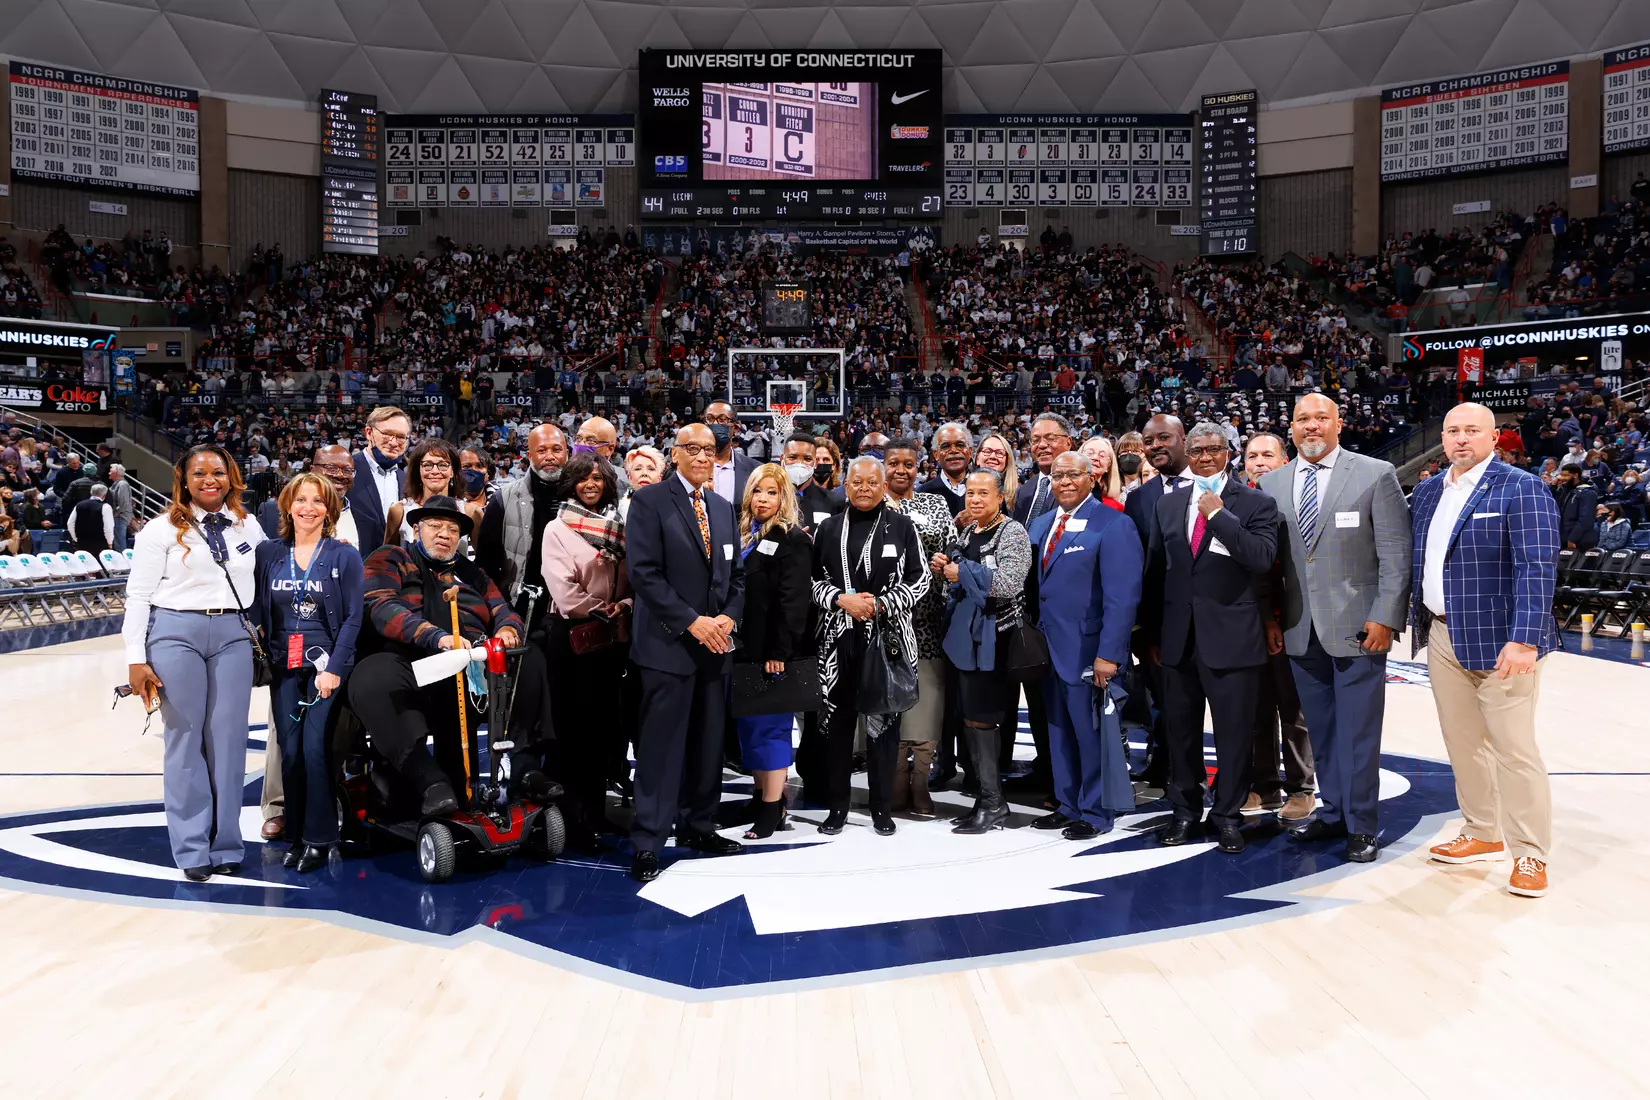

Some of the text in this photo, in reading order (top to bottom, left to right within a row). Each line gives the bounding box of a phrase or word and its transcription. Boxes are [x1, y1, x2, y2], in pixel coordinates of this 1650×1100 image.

[666, 54, 915, 68] UNIVERSITY OF CONNECTICUT
[22, 65, 188, 98] NCAA CHAMPIONSHIP
[1392, 64, 1557, 99] NCAA CHAMPIONSHIP
[1609, 73, 1628, 88] 1991
[20, 77, 190, 108] TOURNAMENT APPEARANCES
[652, 87, 690, 97] WELLS
[1204, 93, 1254, 105] GO HUSKIES
[1426, 90, 1464, 102] SWEET
[15, 86, 195, 123] 1989 1990 1991 1992 1993 1994 1995
[653, 98, 690, 107] FARGO
[1386, 85, 1564, 122] 1991 1994 1995 1996 1997 1998 1999
[1488, 120, 1564, 140] 2011 2012 2013
[745, 126, 753, 153] 3
[784, 131, 804, 162] C
[390, 145, 411, 159] 24
[421, 145, 442, 159] 50
[455, 145, 471, 159] 21
[485, 145, 504, 159] 52
[516, 145, 537, 159] 42
[549, 145, 565, 159] 25
[583, 145, 595, 159] 33
[615, 145, 626, 159] 10
[953, 144, 965, 159] 32
[987, 144, 993, 159] 3
[1047, 144, 1059, 159] 20
[1078, 144, 1089, 159] 31
[1108, 144, 1121, 159] 23
[1139, 144, 1152, 159] 31
[1171, 144, 1184, 159] 14
[1384, 137, 1562, 171] 2014 2015 2016 2017 2018 2019 2021
[1382, 153, 1566, 182] CONNECTICUT WOMEN'S BASKETBALL
[16, 170, 195, 197] CONNECTICUT WOMEN'S BASKETBALL
[782, 191, 808, 203] 4:49
[950, 184, 968, 199] 23
[985, 184, 994, 199] 4
[1013, 184, 1030, 199] 30
[1048, 184, 1057, 199] 3
[1074, 184, 1092, 199] CD
[1107, 184, 1121, 199] 15
[1135, 184, 1156, 199] 24
[1167, 184, 1187, 199] 33
[112, 205, 123, 213] 14
[644, 197, 663, 211] 44
[922, 196, 941, 211] 27
[392, 227, 408, 235] 201
[797, 230, 814, 238] Harry
[823, 230, 845, 238] Gampel
[1209, 228, 1248, 238] TIME OF DAY
[838, 238, 859, 246] Capital
[1224, 238, 1247, 251] 1:10
[776, 290, 804, 302] 4:49
[1425, 338, 1476, 351] FOLLOW
[1479, 324, 1629, 349] @UCONNHUSKIES
[1603, 346, 1620, 355] Lite
[47, 384, 99, 403] Coke
[198, 395, 216, 404] 101
[424, 396, 442, 404] 101
[512, 396, 532, 405] 102
[744, 396, 764, 405] 102
[1062, 395, 1083, 404] 104
[1383, 394, 1399, 403] 05
[1472, 388, 1528, 399] MICHAELS
[56, 401, 91, 412] zero
[271, 579, 323, 593] UCON
